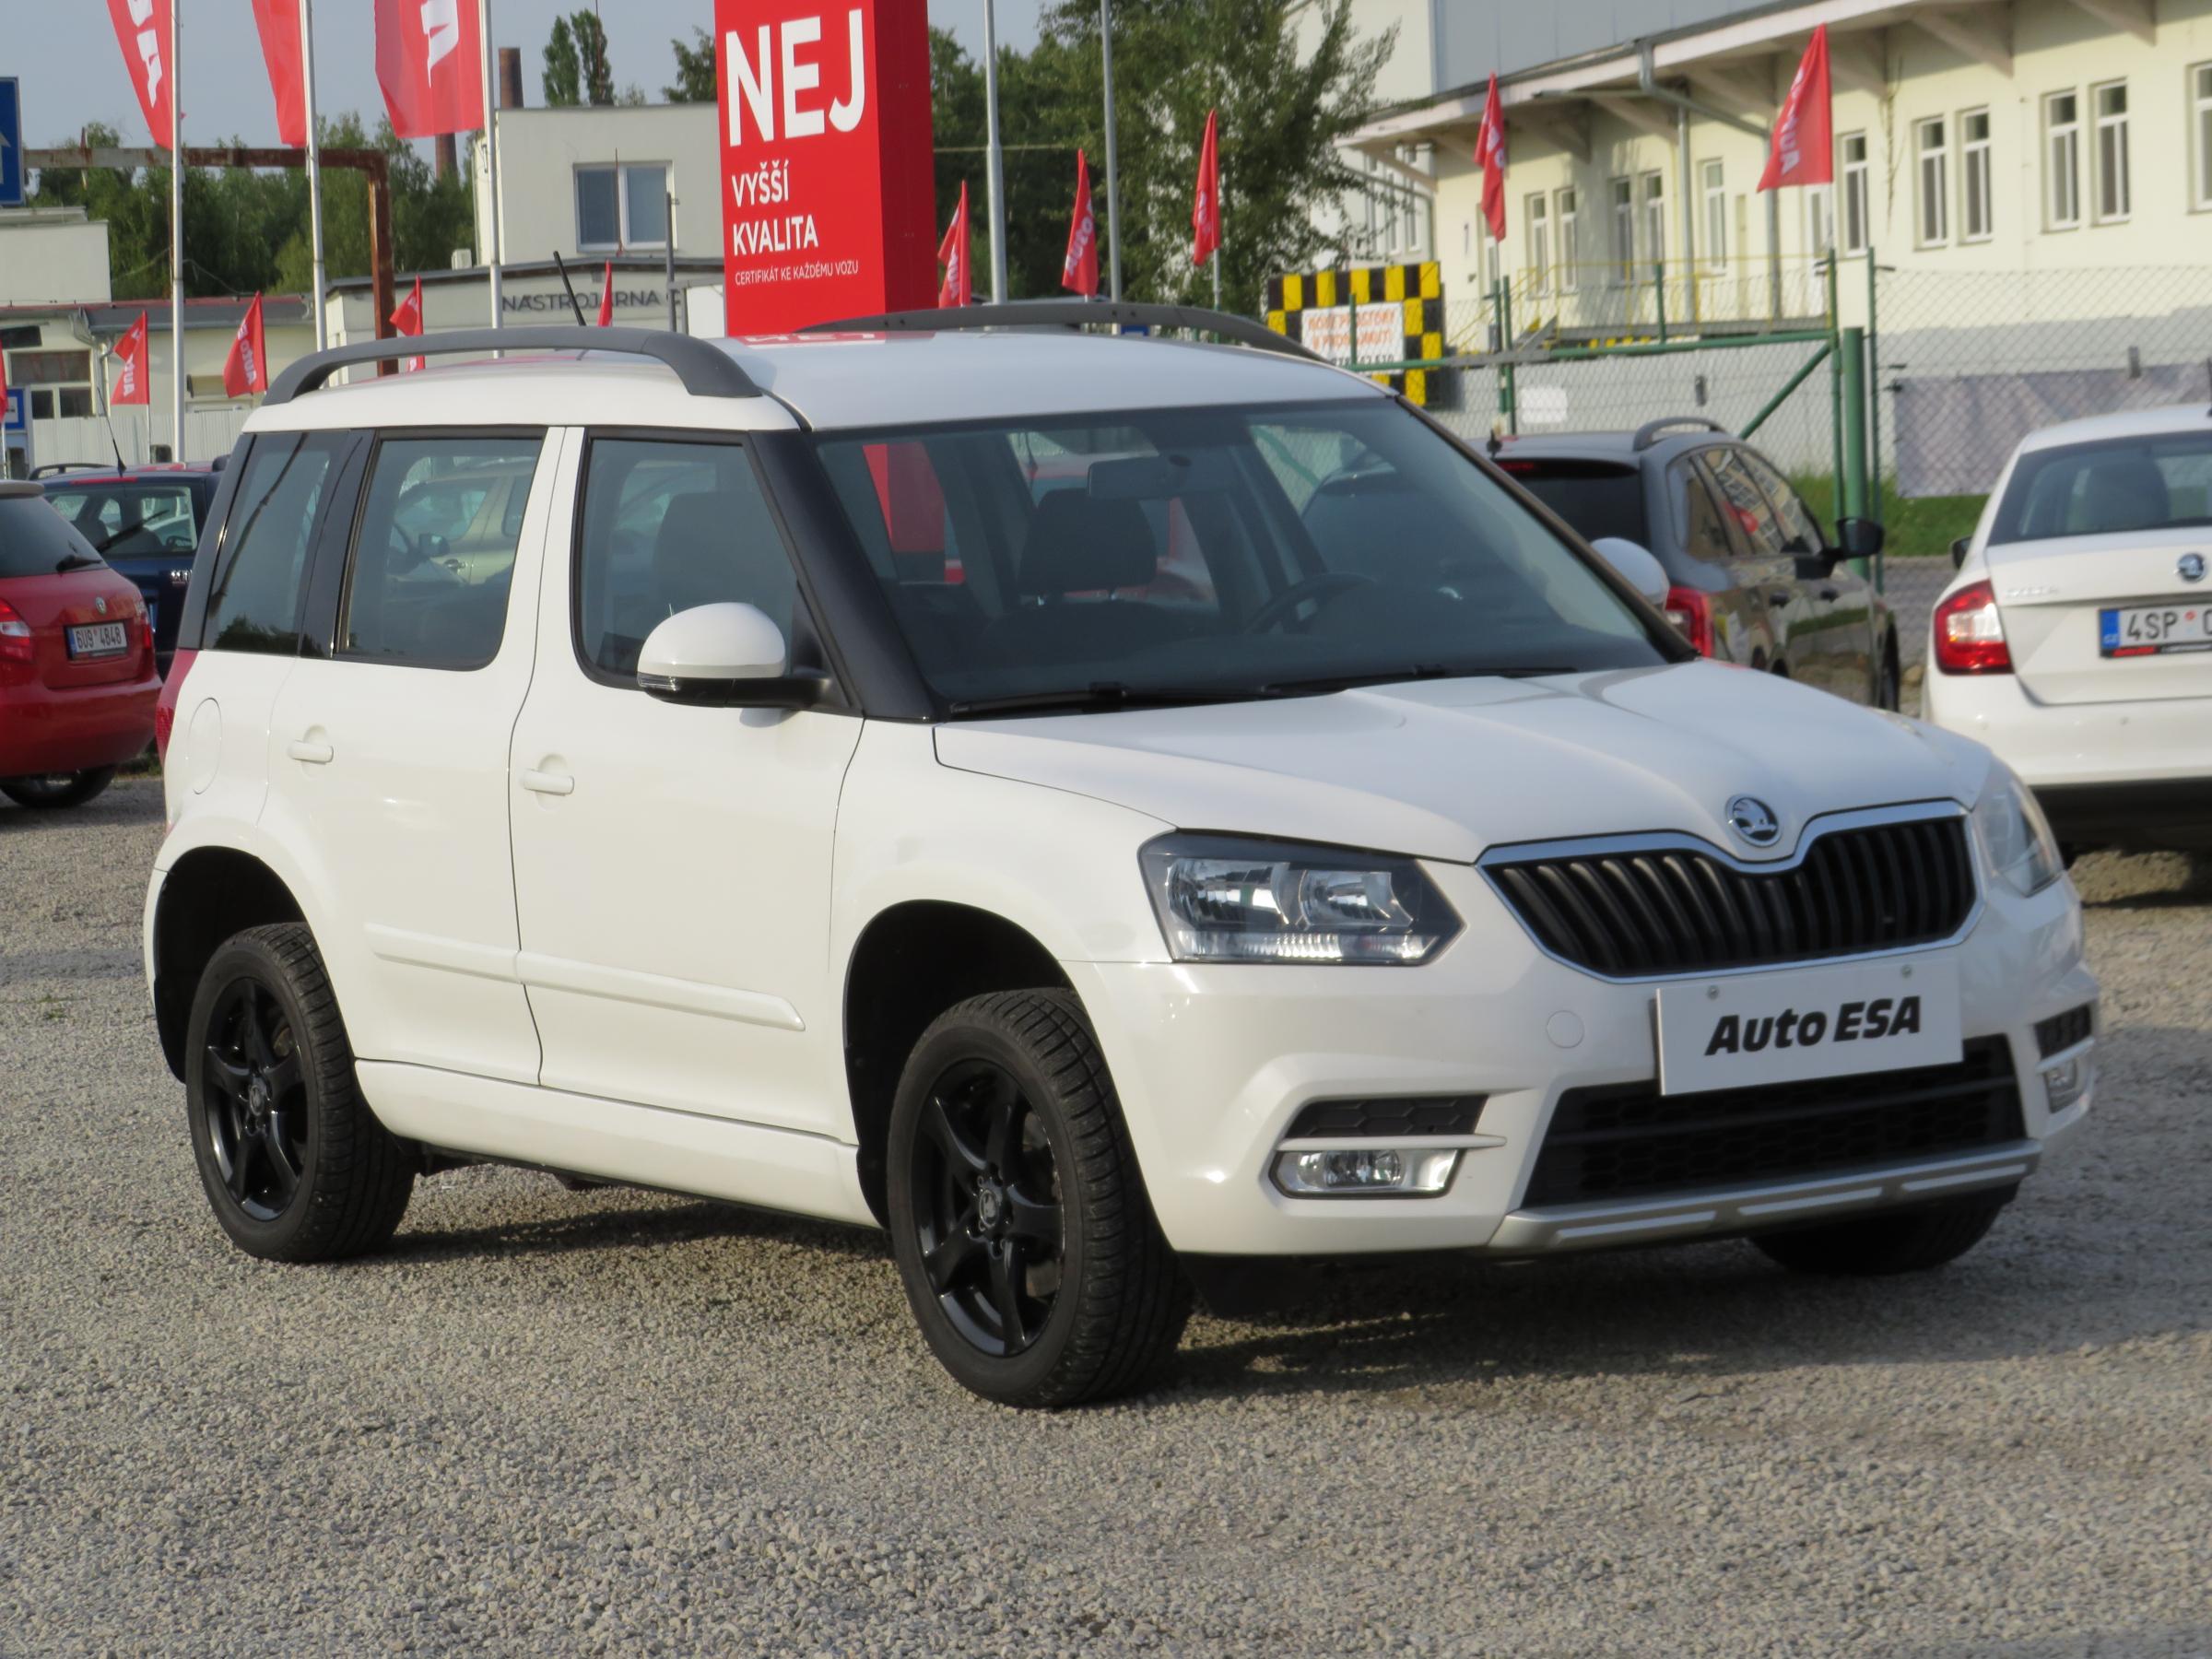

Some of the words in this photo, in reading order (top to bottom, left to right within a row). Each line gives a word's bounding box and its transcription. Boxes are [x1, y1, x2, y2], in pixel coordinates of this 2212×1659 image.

[725, 8, 865, 147] NEJ
[731, 159, 790, 207] VYŠŠÍ
[733, 214, 819, 256] KVALITA
[735, 265, 779, 286] CERTIFIKÁT
[781, 266, 792, 281] KE
[793, 261, 833, 279] KAŽDÉMU
[835, 259, 859, 276] VOZU
[502, 288, 661, 312] NÁSTROJRNA
[2127, 611, 2178, 641] 4SP
[1704, 1008, 1828, 1055] Auto
[1833, 995, 1921, 1041] ESA
